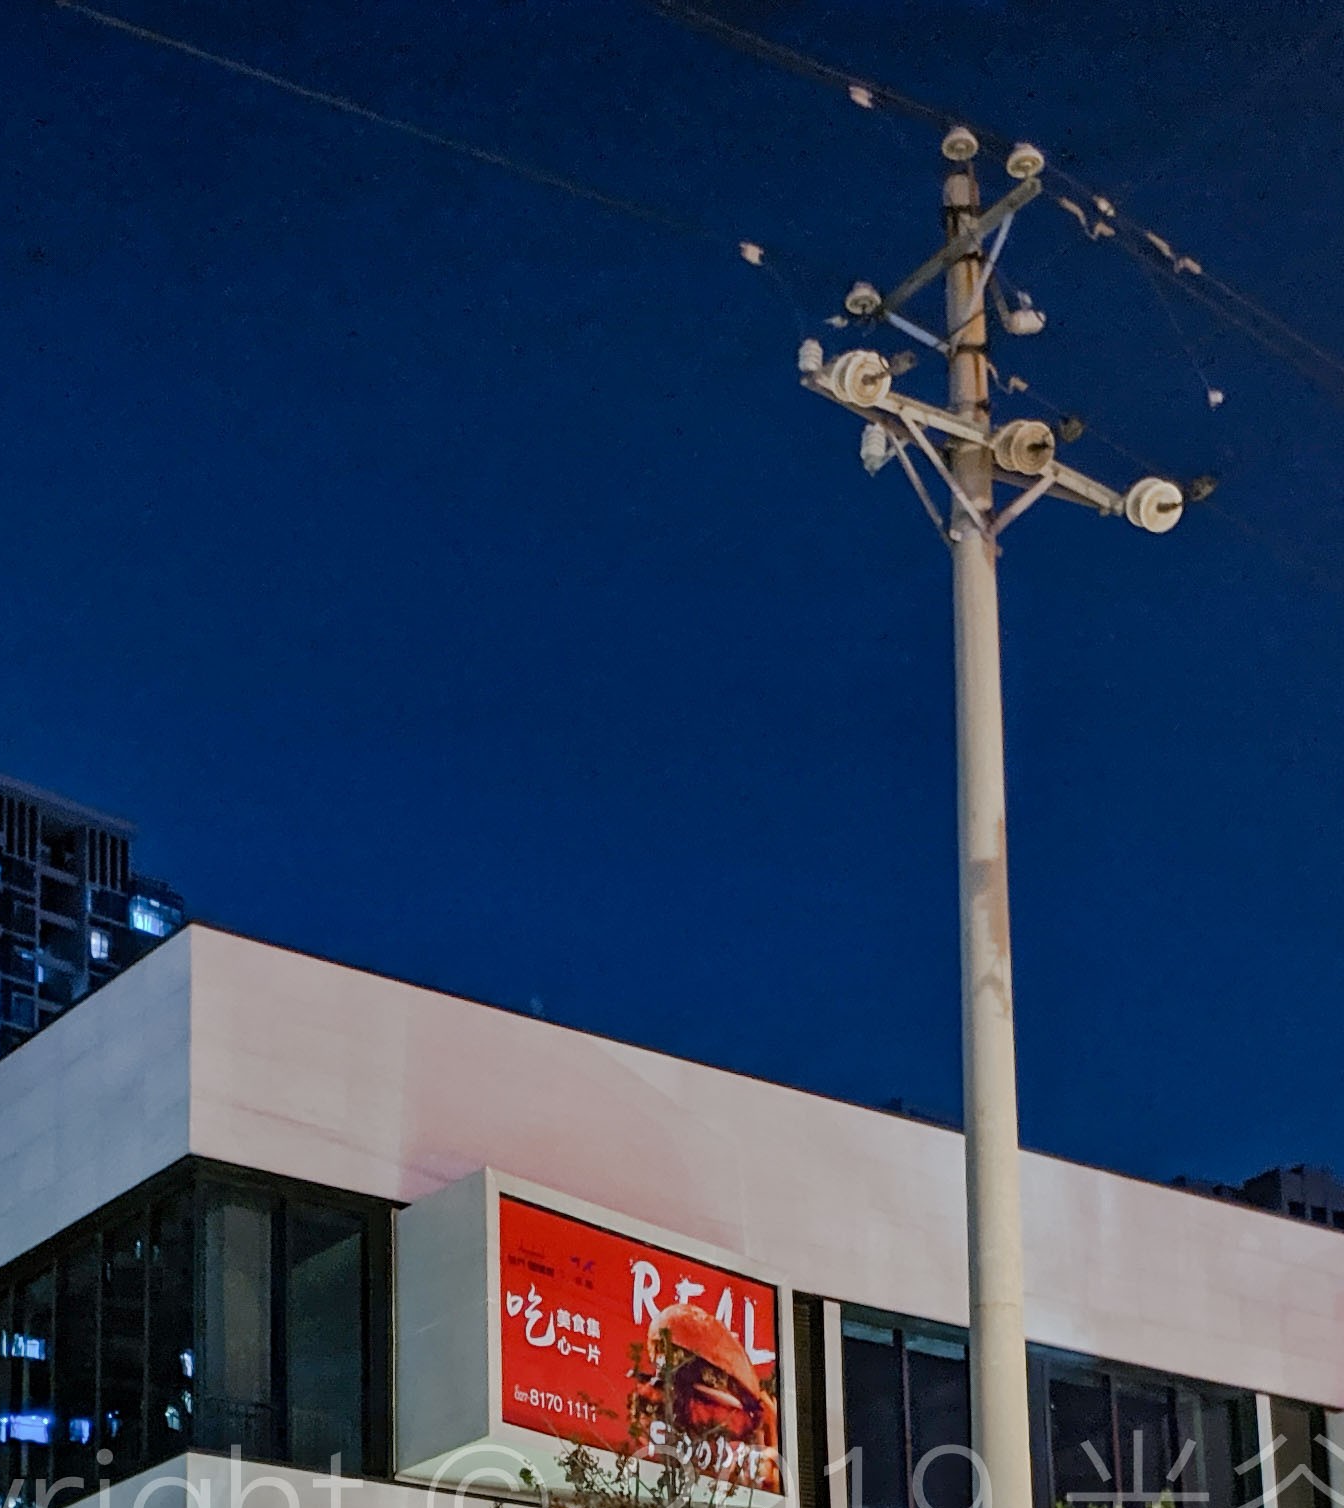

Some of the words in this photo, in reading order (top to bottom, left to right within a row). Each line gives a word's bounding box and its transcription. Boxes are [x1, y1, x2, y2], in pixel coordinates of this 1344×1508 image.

[506, 1282, 556, 1347] 吃
[557, 1335, 601, 1366] 心一片
